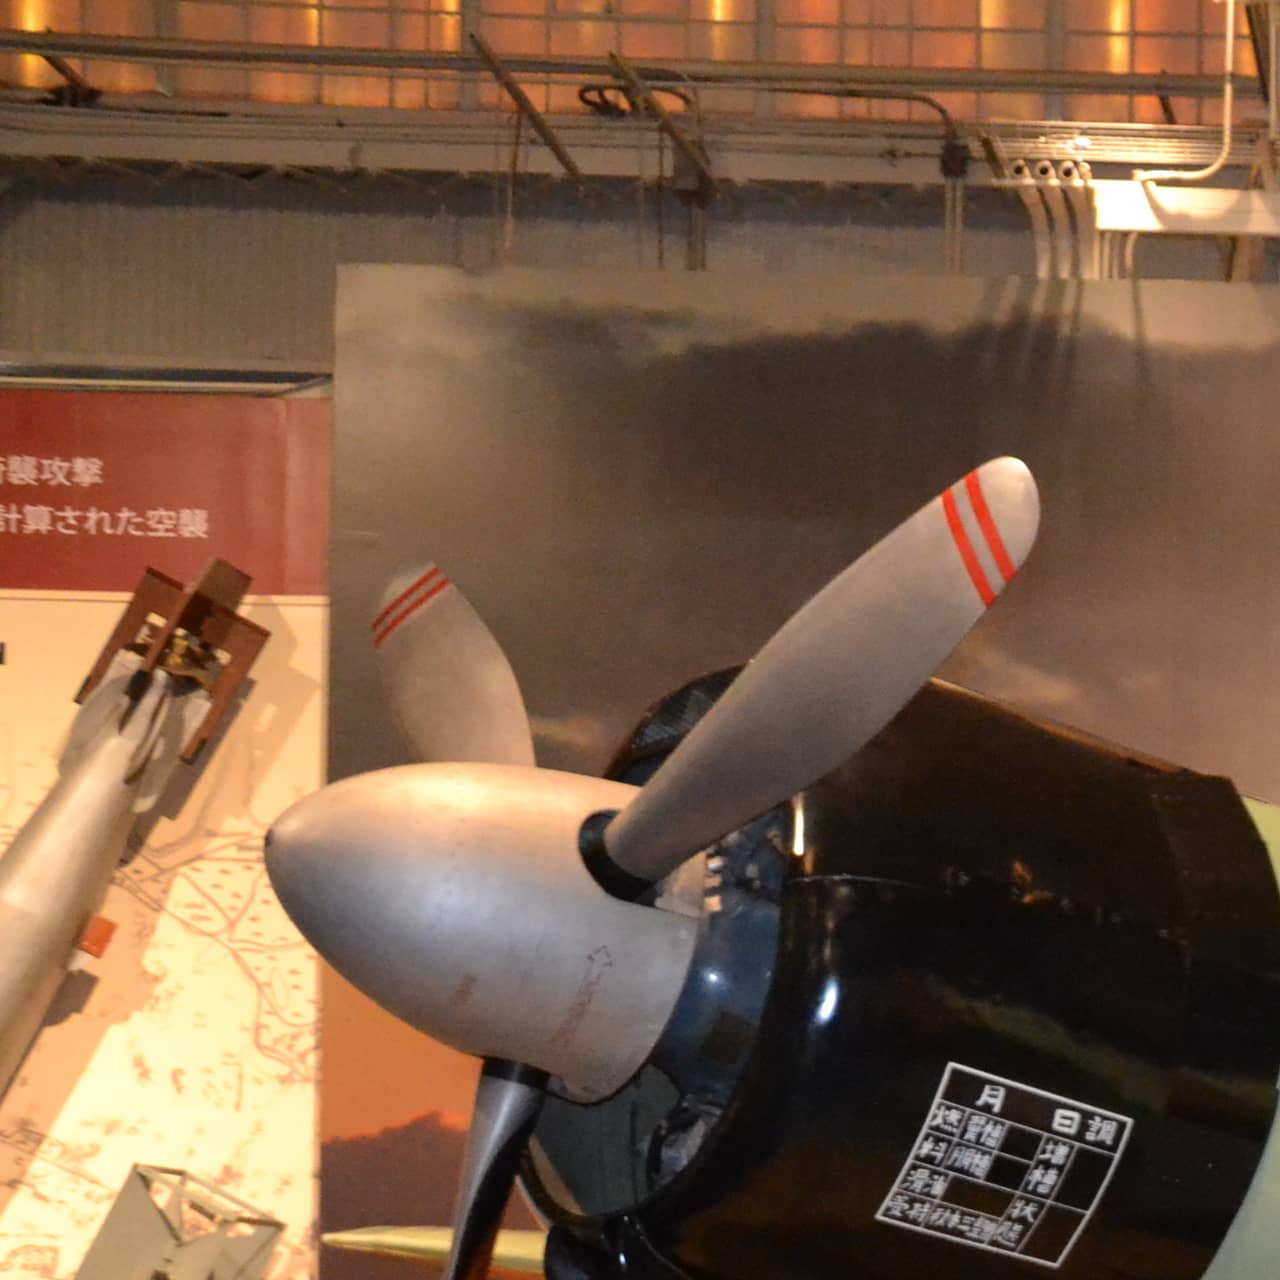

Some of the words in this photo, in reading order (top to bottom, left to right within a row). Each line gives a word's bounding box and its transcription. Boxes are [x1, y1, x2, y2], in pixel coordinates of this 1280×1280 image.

[0, 456, 104, 487] 襲攻撃
[975, 1085, 1006, 1113] 月
